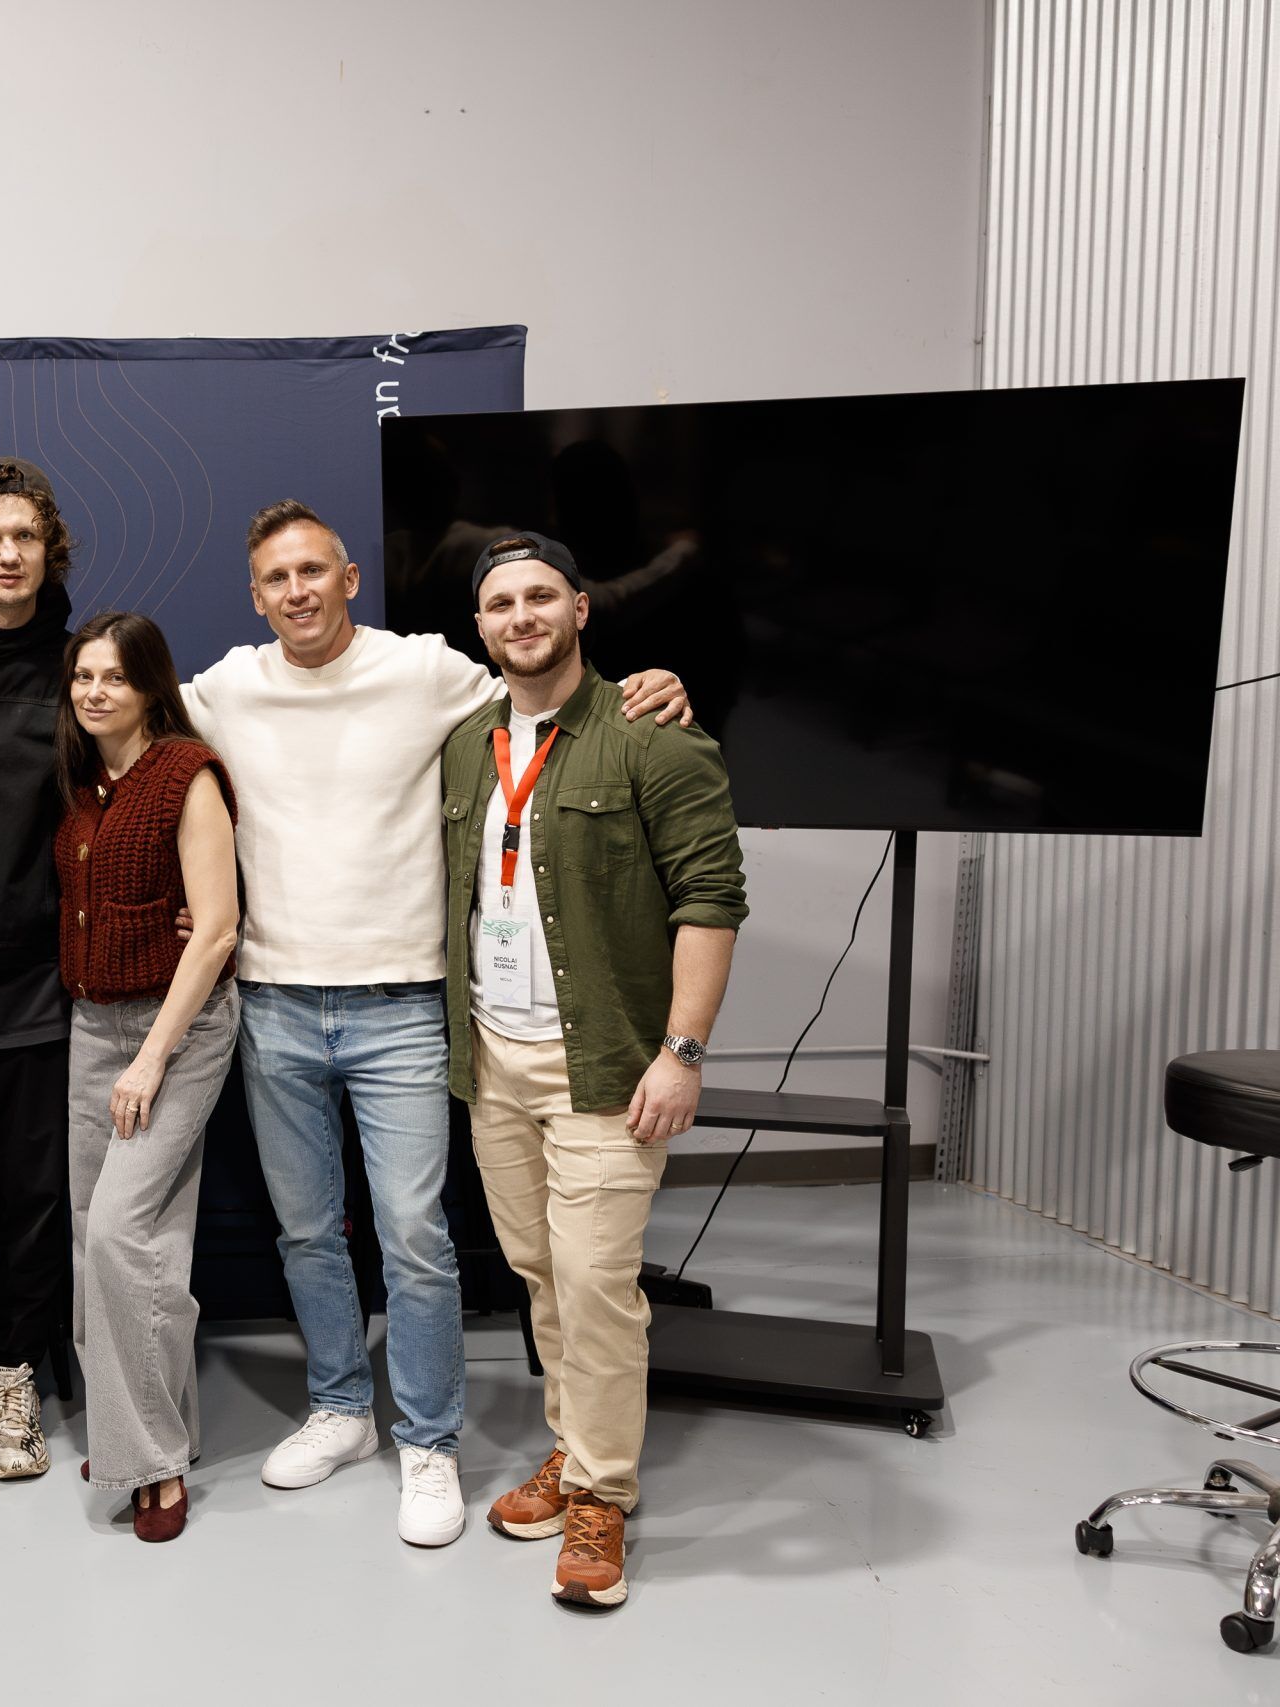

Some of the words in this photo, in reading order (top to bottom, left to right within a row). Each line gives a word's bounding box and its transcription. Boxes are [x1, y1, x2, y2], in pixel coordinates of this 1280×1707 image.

[373, 331, 423, 365] fr
[376, 381, 401, 427] an
[493, 963, 518, 971] RUSNAC
[11, 1460, 22, 1471] 44
